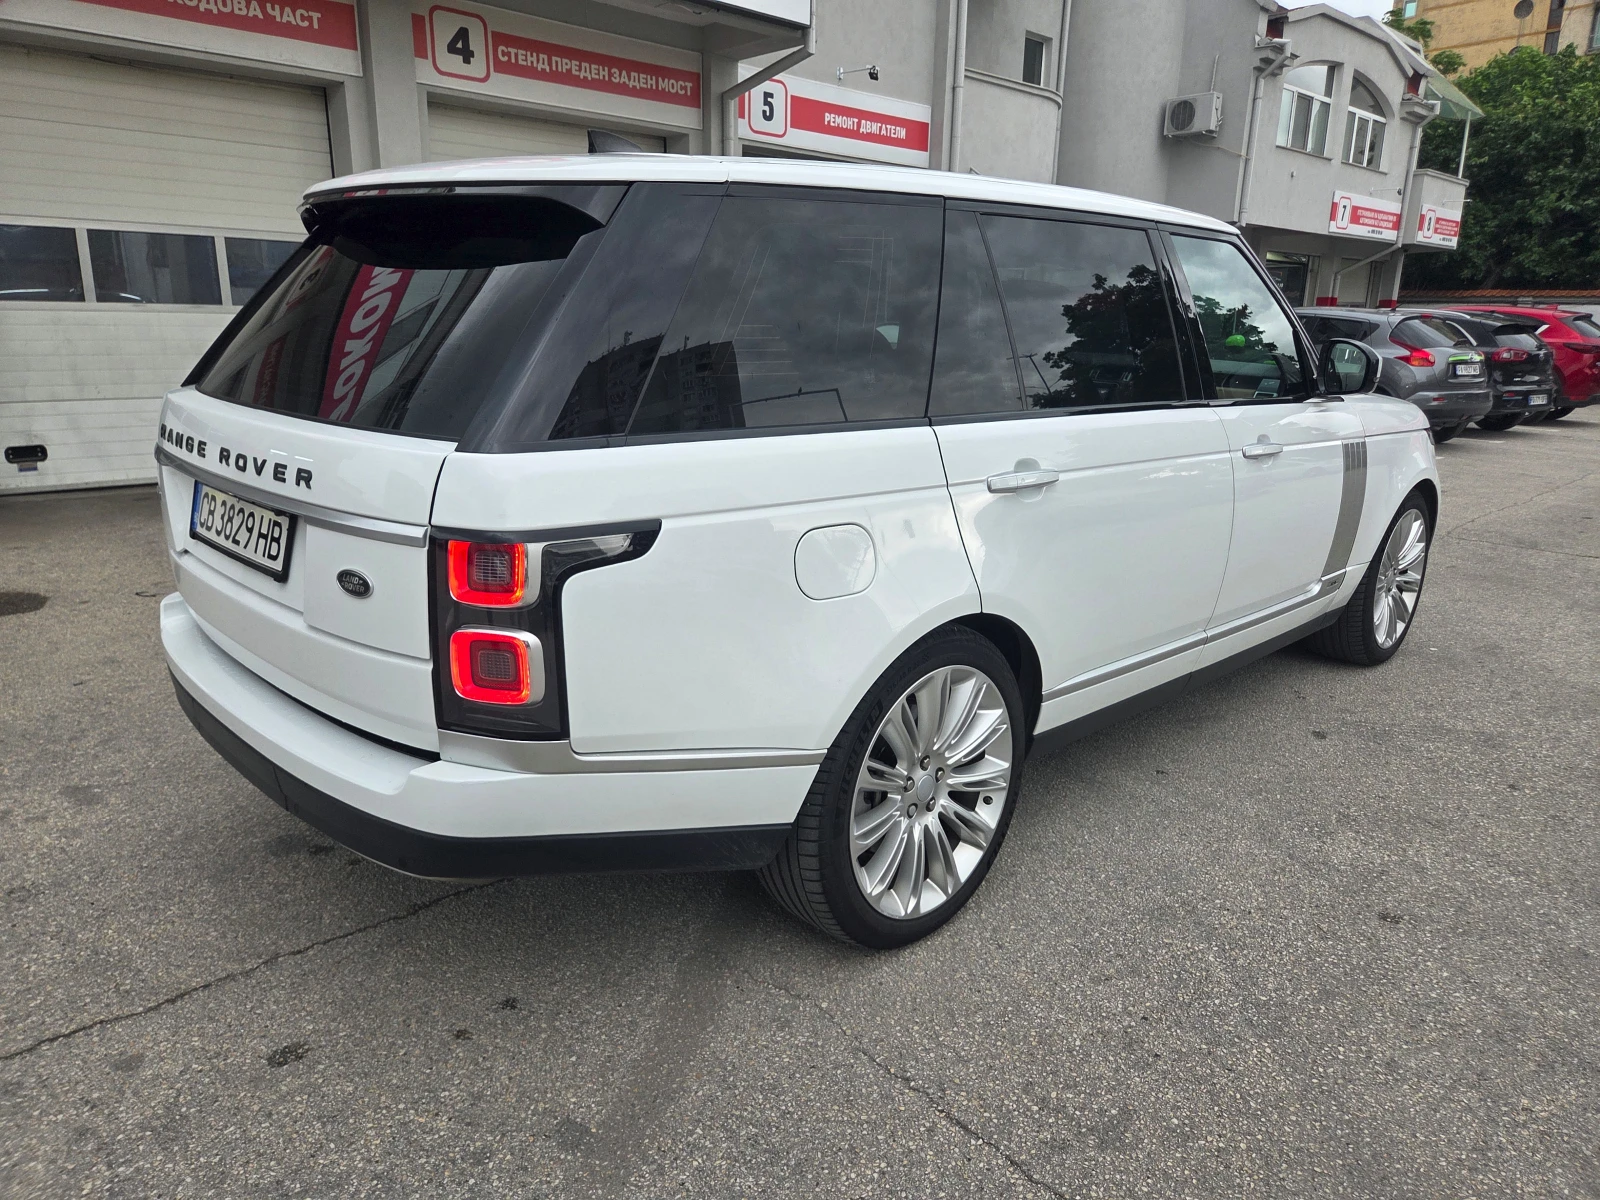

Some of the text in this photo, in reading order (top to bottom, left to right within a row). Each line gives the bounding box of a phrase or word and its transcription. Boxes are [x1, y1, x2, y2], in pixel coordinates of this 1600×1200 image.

[266, 3, 322, 30] ЧАСТ
[446, 26, 475, 65] 4
[497, 45, 693, 96] СТЕНД ПРЕДЕН ЗАДЕН МОСТ
[761, 91, 775, 122] 5
[824, 112, 906, 140] РЕМОНТ ДВИГАТЕЛИ
[1340, 204, 1347, 222] 7
[160, 423, 313, 490] RANGE ROVER
[215, 499, 256, 550] 3829
[254, 514, 283, 561] HB
[342, 573, 359, 585] LAND
[344, 581, 365, 594] ROVER
